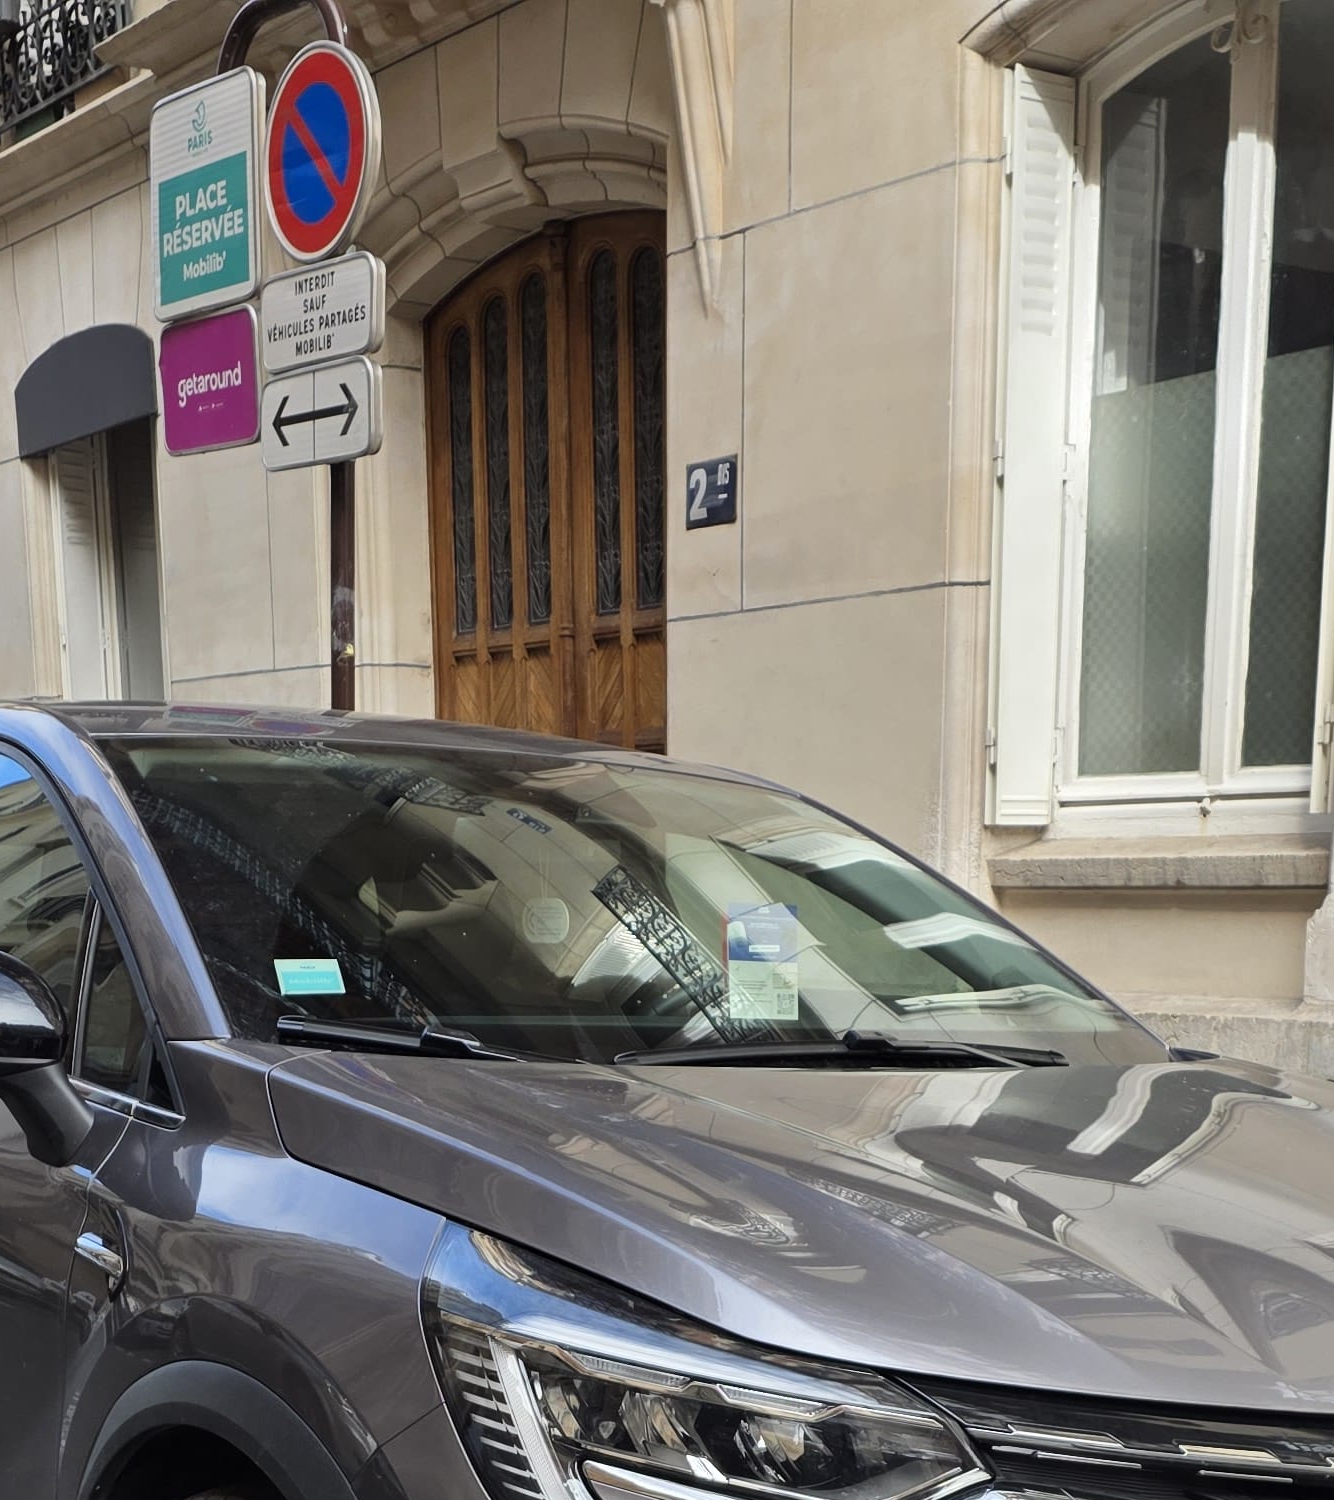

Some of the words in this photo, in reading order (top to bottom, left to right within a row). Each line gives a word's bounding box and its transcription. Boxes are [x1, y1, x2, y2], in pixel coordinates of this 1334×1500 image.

[187, 129, 214, 153] PARIS
[175, 179, 228, 221] PLACE
[162, 203, 245, 259] RÉSERVÉE
[294, 270, 336, 296] INTERDIT
[303, 293, 327, 314] SAUF
[267, 318, 315, 343] VÉHICULES
[318, 302, 366, 331] PARTAGÉS
[177, 360, 242, 408] getaround
[689, 467, 708, 521] 2
